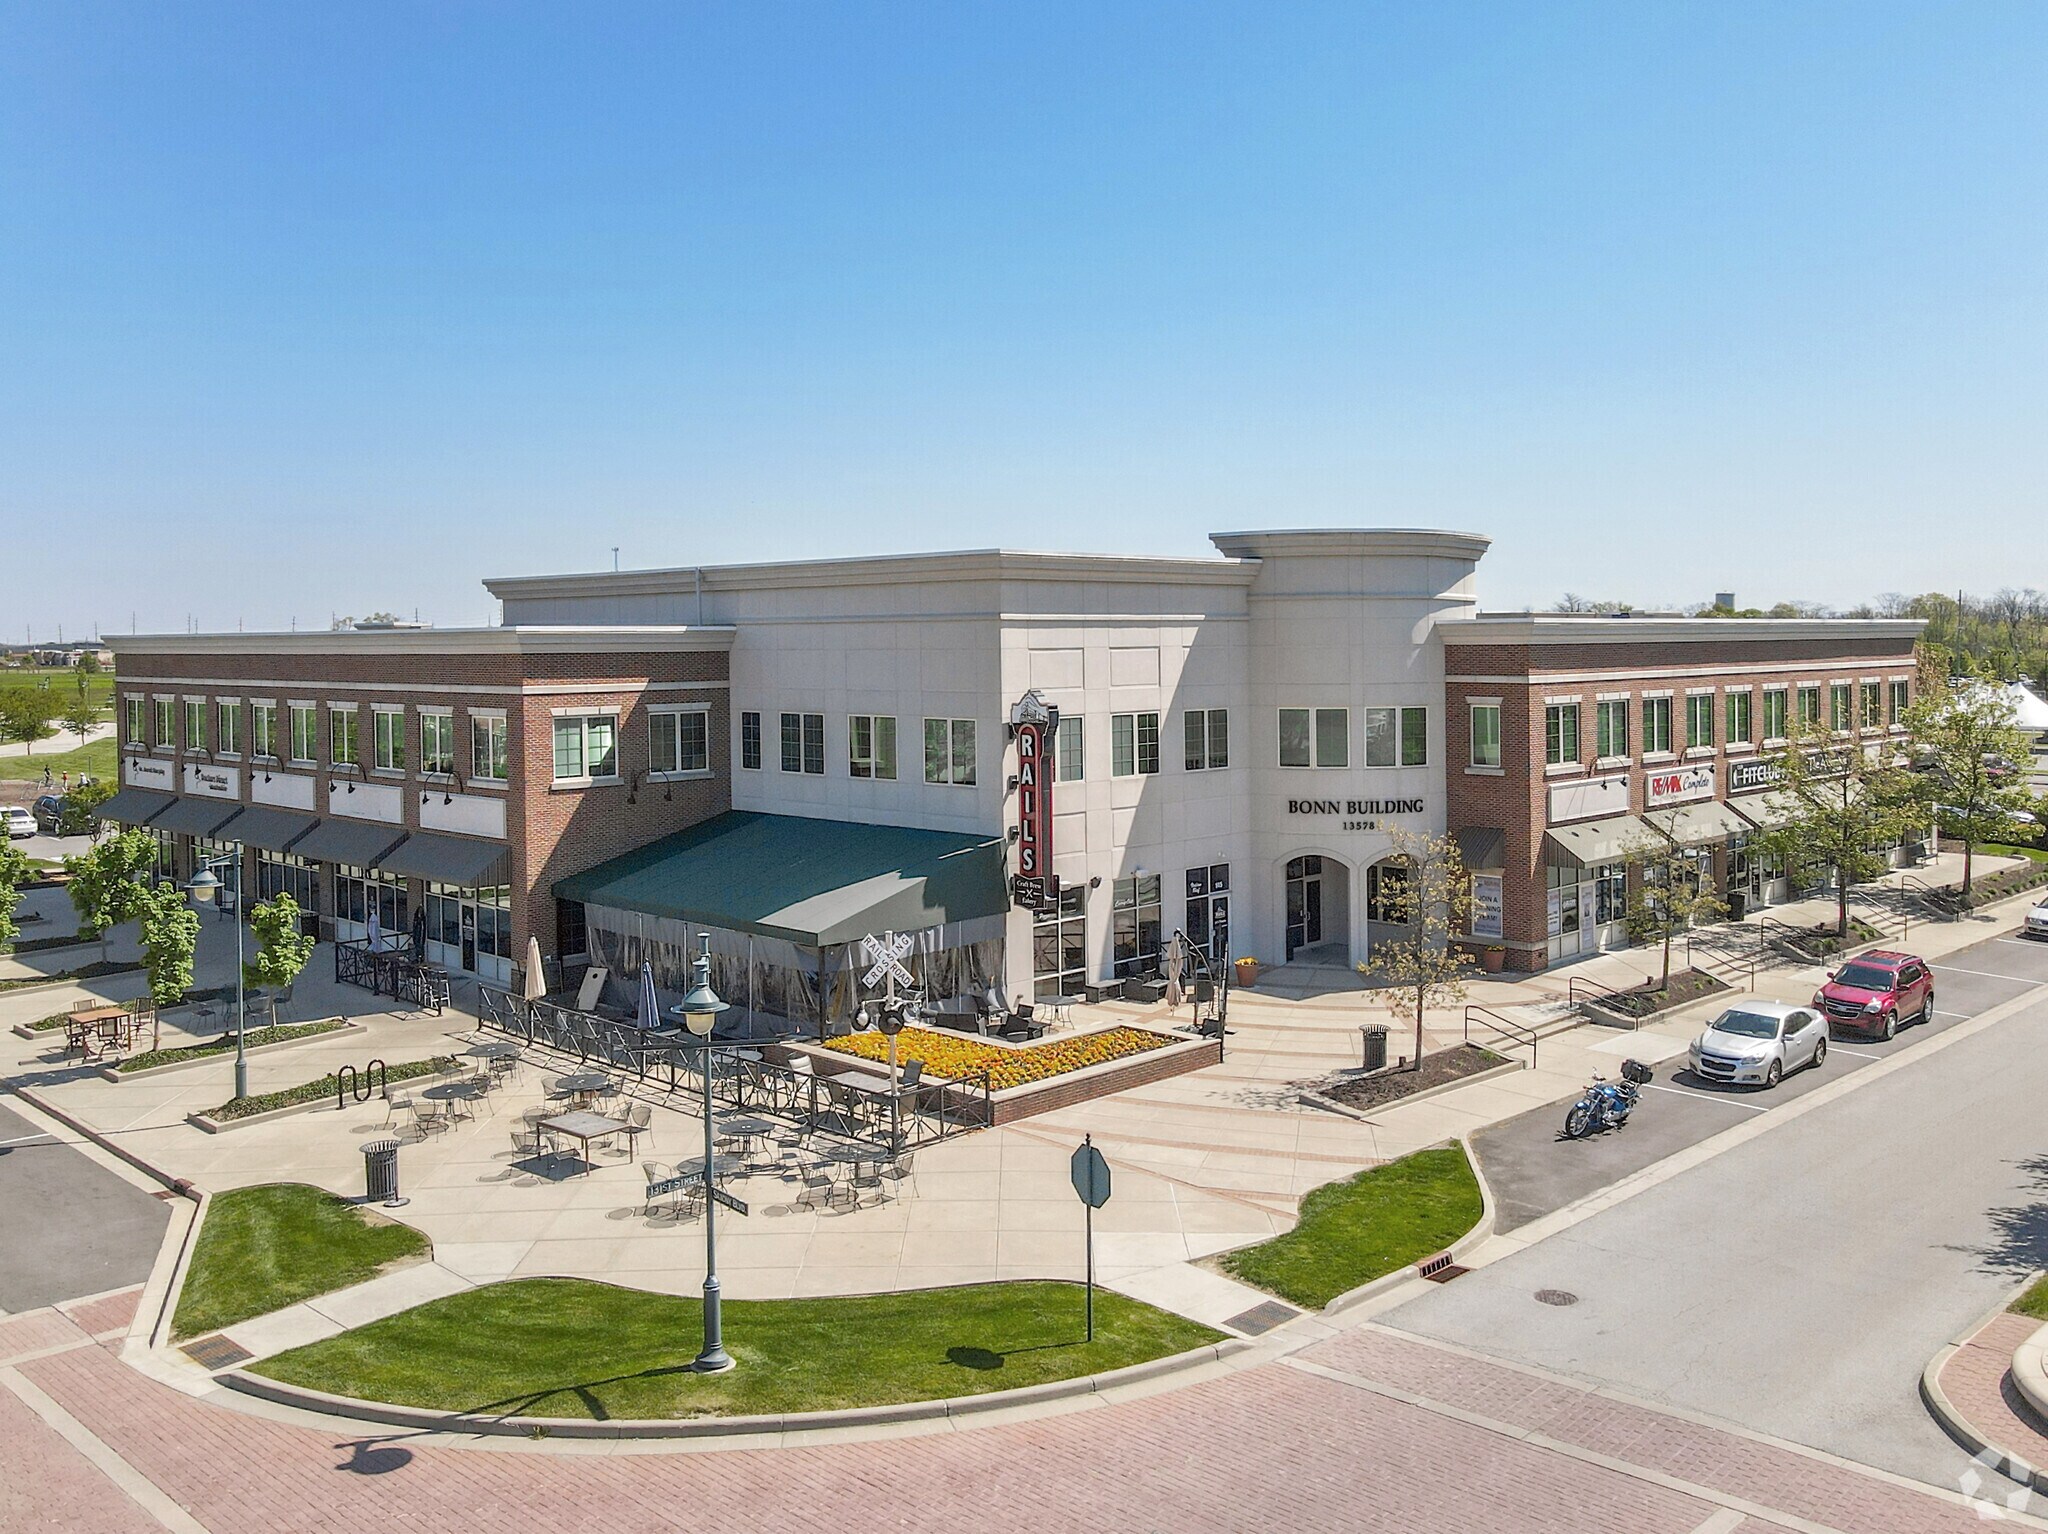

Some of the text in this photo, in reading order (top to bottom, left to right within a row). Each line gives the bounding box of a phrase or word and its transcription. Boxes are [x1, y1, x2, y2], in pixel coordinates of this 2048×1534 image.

[1021, 734, 1034, 871] RAILS
[1288, 799, 1423, 814] BONN BUILDING
[1343, 822, 1375, 830] 13578
[1016, 880, 1029, 888] Craft
[863, 937, 911, 985] RAIL ROAD
[865, 937, 909, 985] CROSSING
[649, 1173, 703, 1195] 131ST STREET
